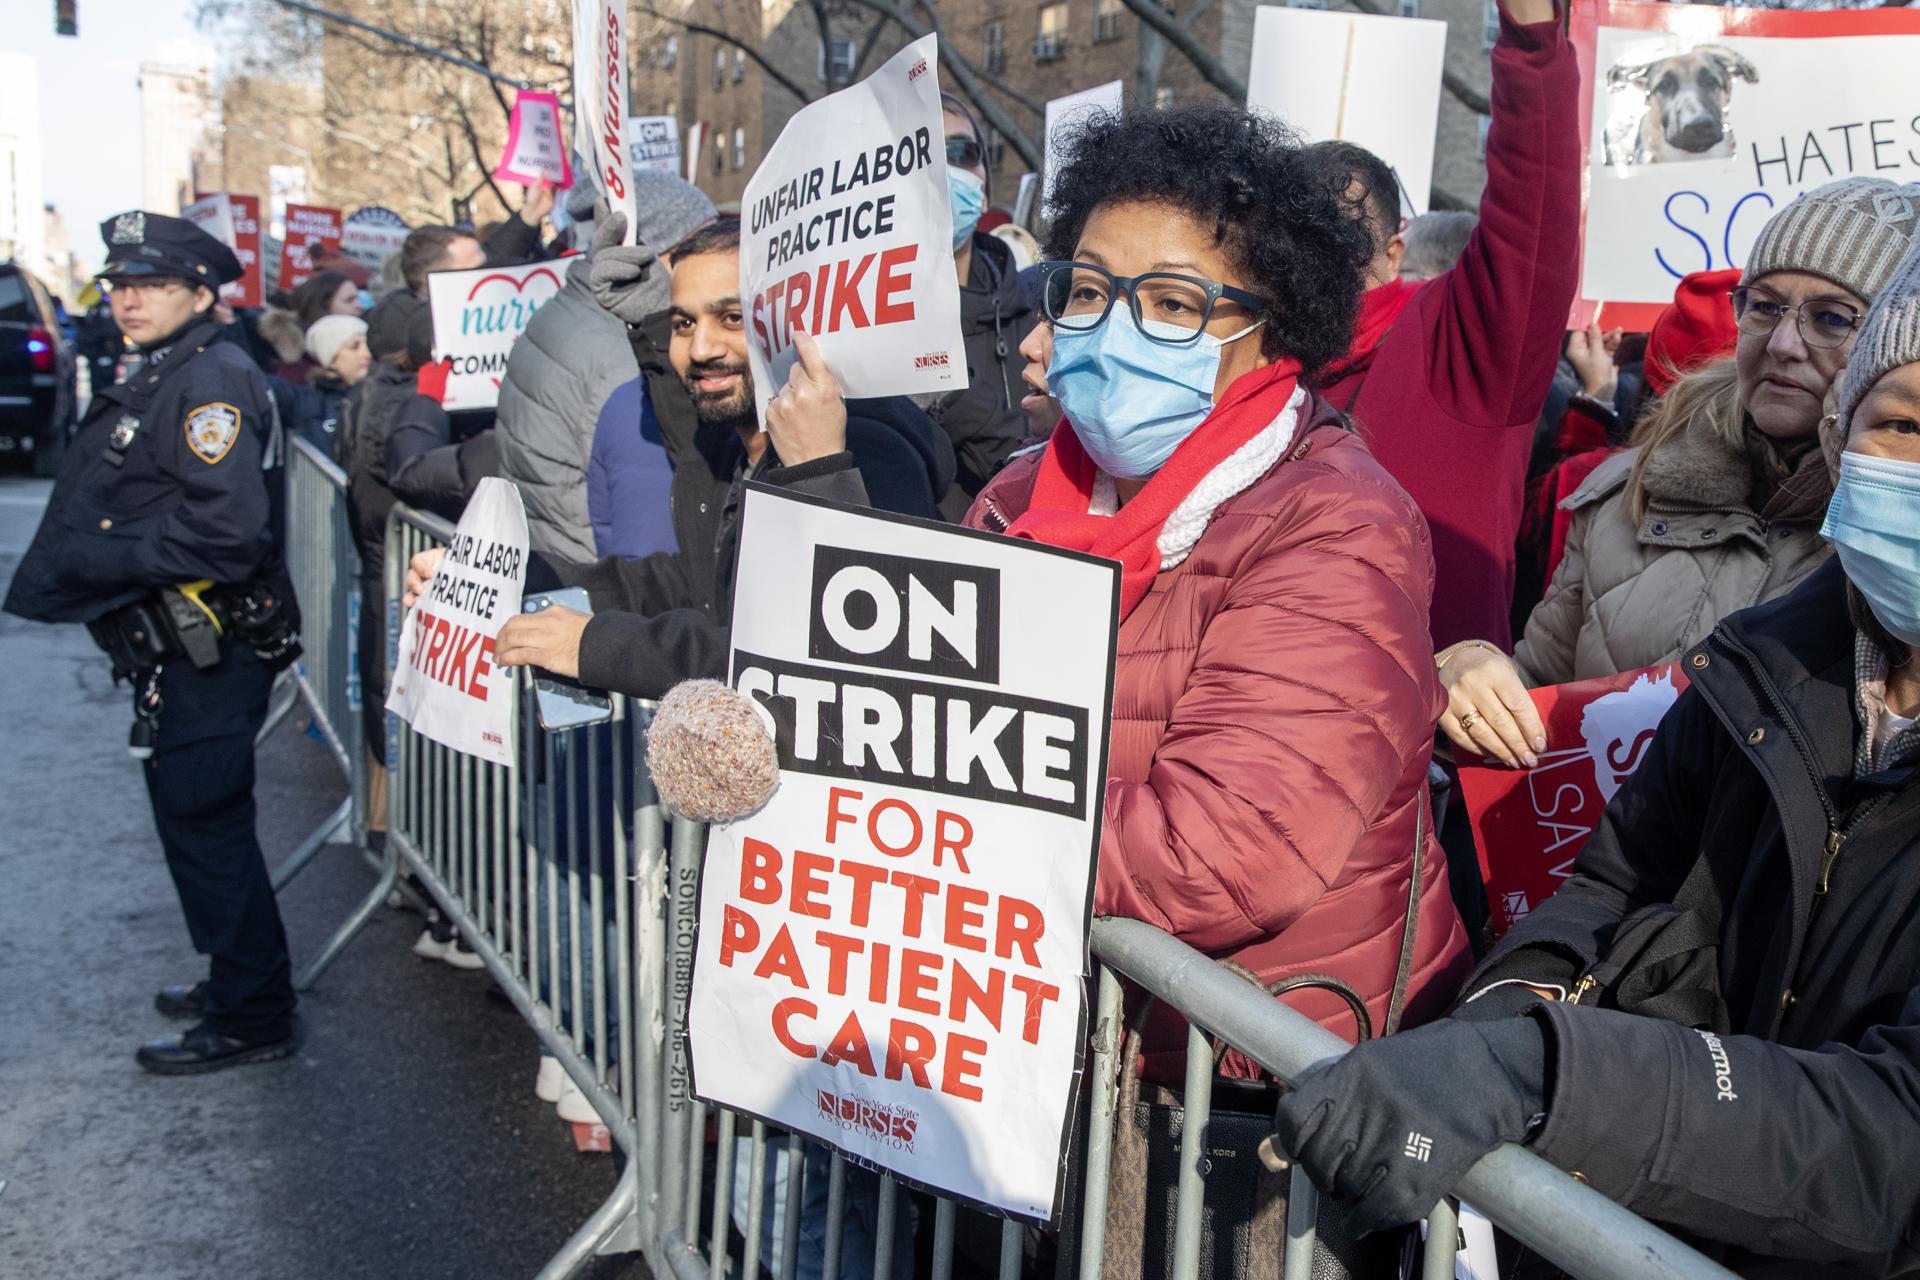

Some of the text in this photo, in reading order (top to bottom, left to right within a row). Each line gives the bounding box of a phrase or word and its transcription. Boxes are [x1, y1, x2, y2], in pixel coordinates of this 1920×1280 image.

[604, 6, 622, 167] Nurses
[751, 126, 932, 235] UNFAIR LABOR
[768, 194, 896, 272] PRACTICE
[752, 243, 919, 363] STRIKE
[430, 571, 499, 620] PRACTICE
[474, 538, 520, 581] LABOR
[410, 609, 497, 702] STRIKE
[822, 565, 977, 670] ON
[737, 666, 1075, 804] STRIKE
[825, 786, 974, 874] FOR
[739, 836, 1046, 968] BETTER
[719, 903, 1060, 1046] PATIENT
[771, 997, 988, 1103] CARE
[817, 1088, 918, 1142] NURSES
[817, 1110, 915, 1154] ASSOCIATION
[850, 1092, 919, 1120] New York State
